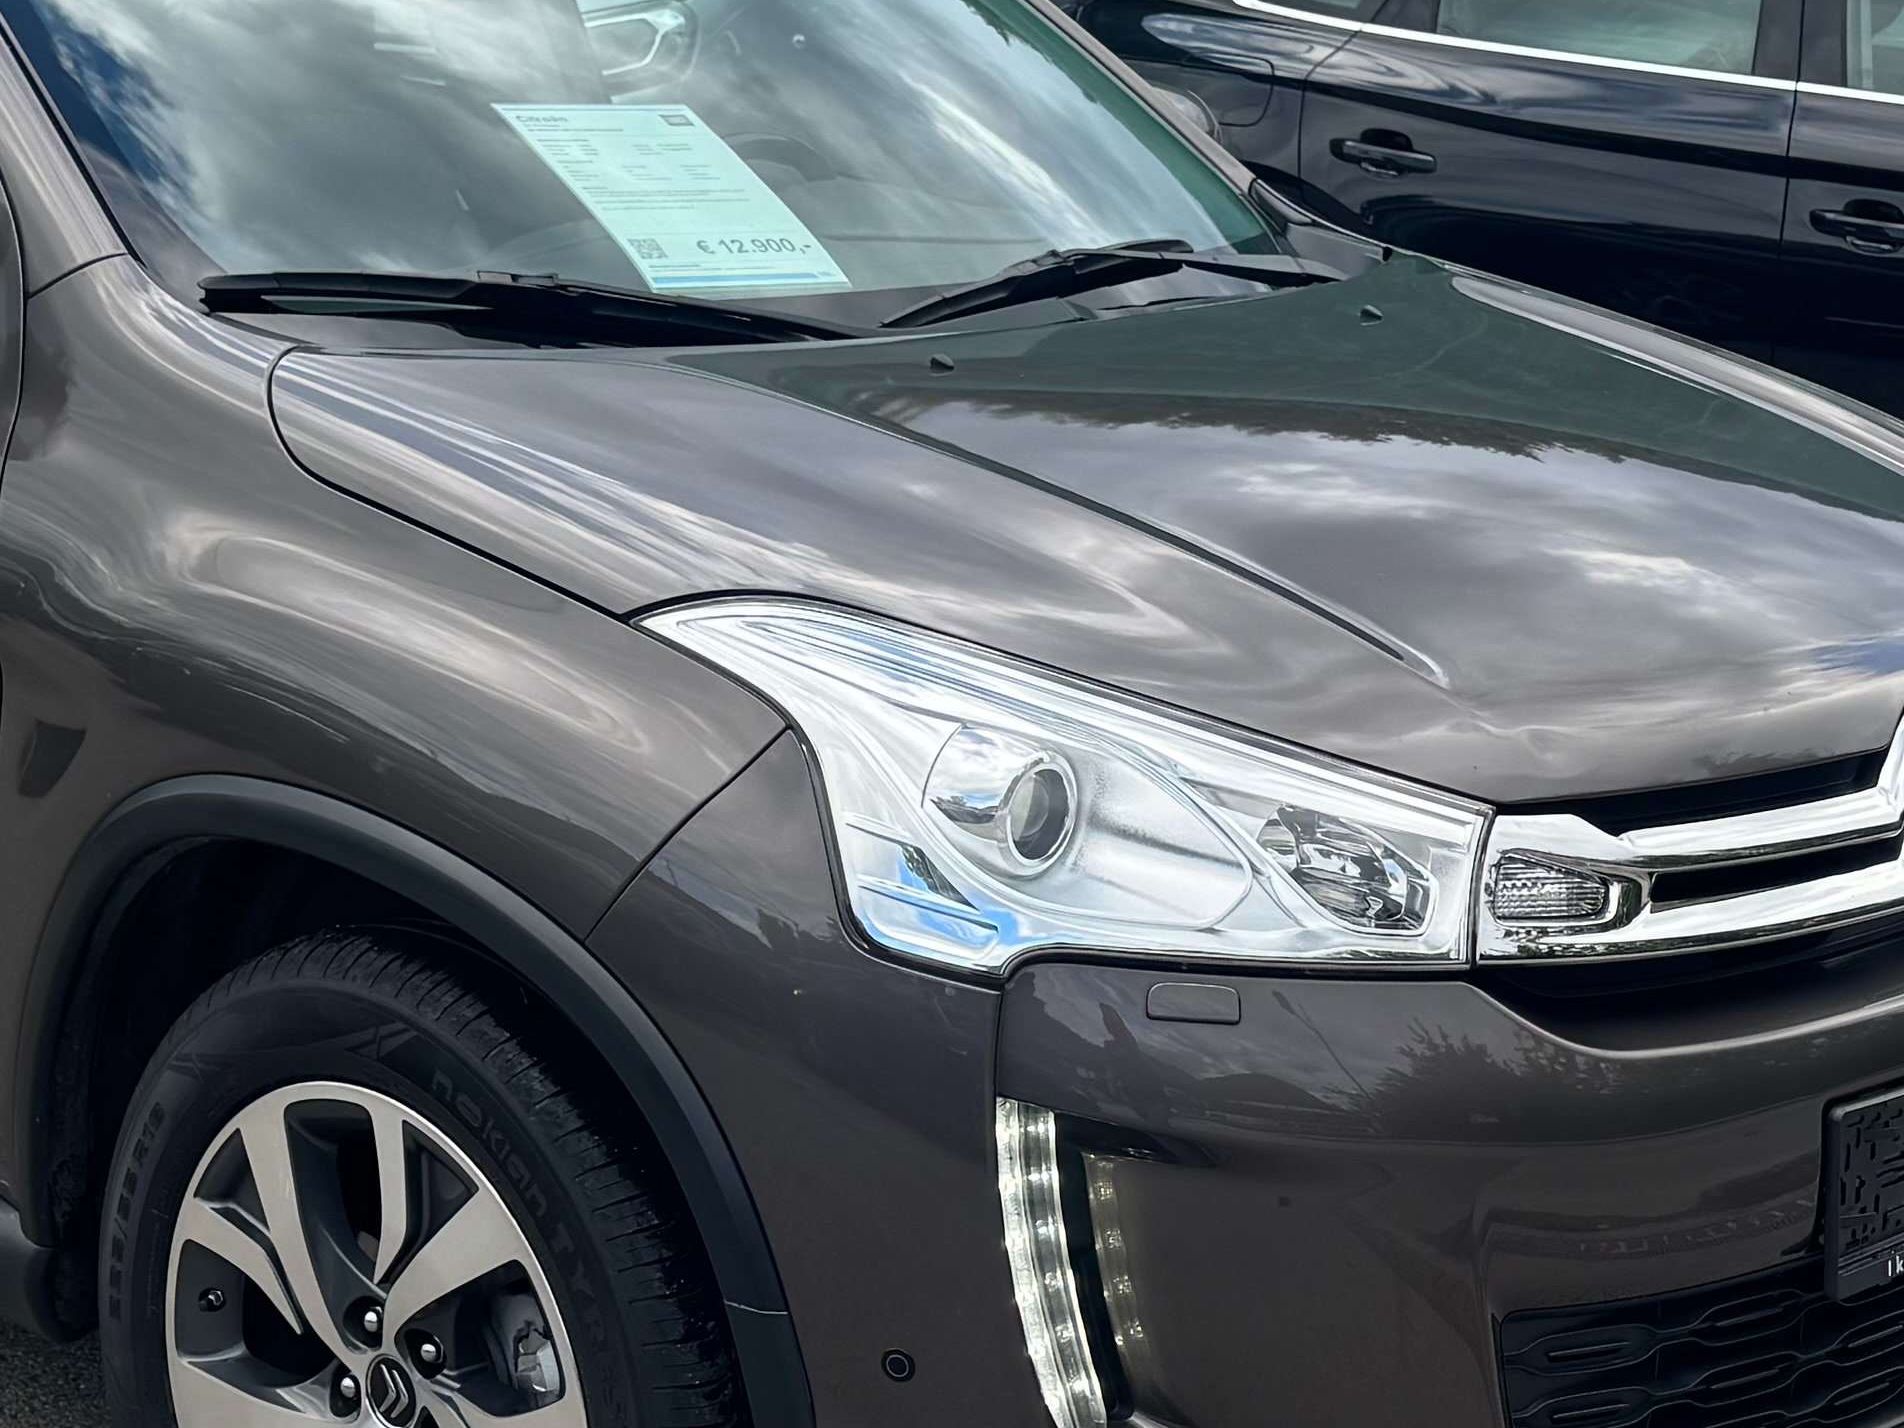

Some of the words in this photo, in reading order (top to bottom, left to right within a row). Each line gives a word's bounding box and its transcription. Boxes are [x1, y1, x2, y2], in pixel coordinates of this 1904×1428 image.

[696, 239, 716, 255] €
[719, 237, 812, 254] 12.900,-
[431, 1068, 548, 1219] nokian
